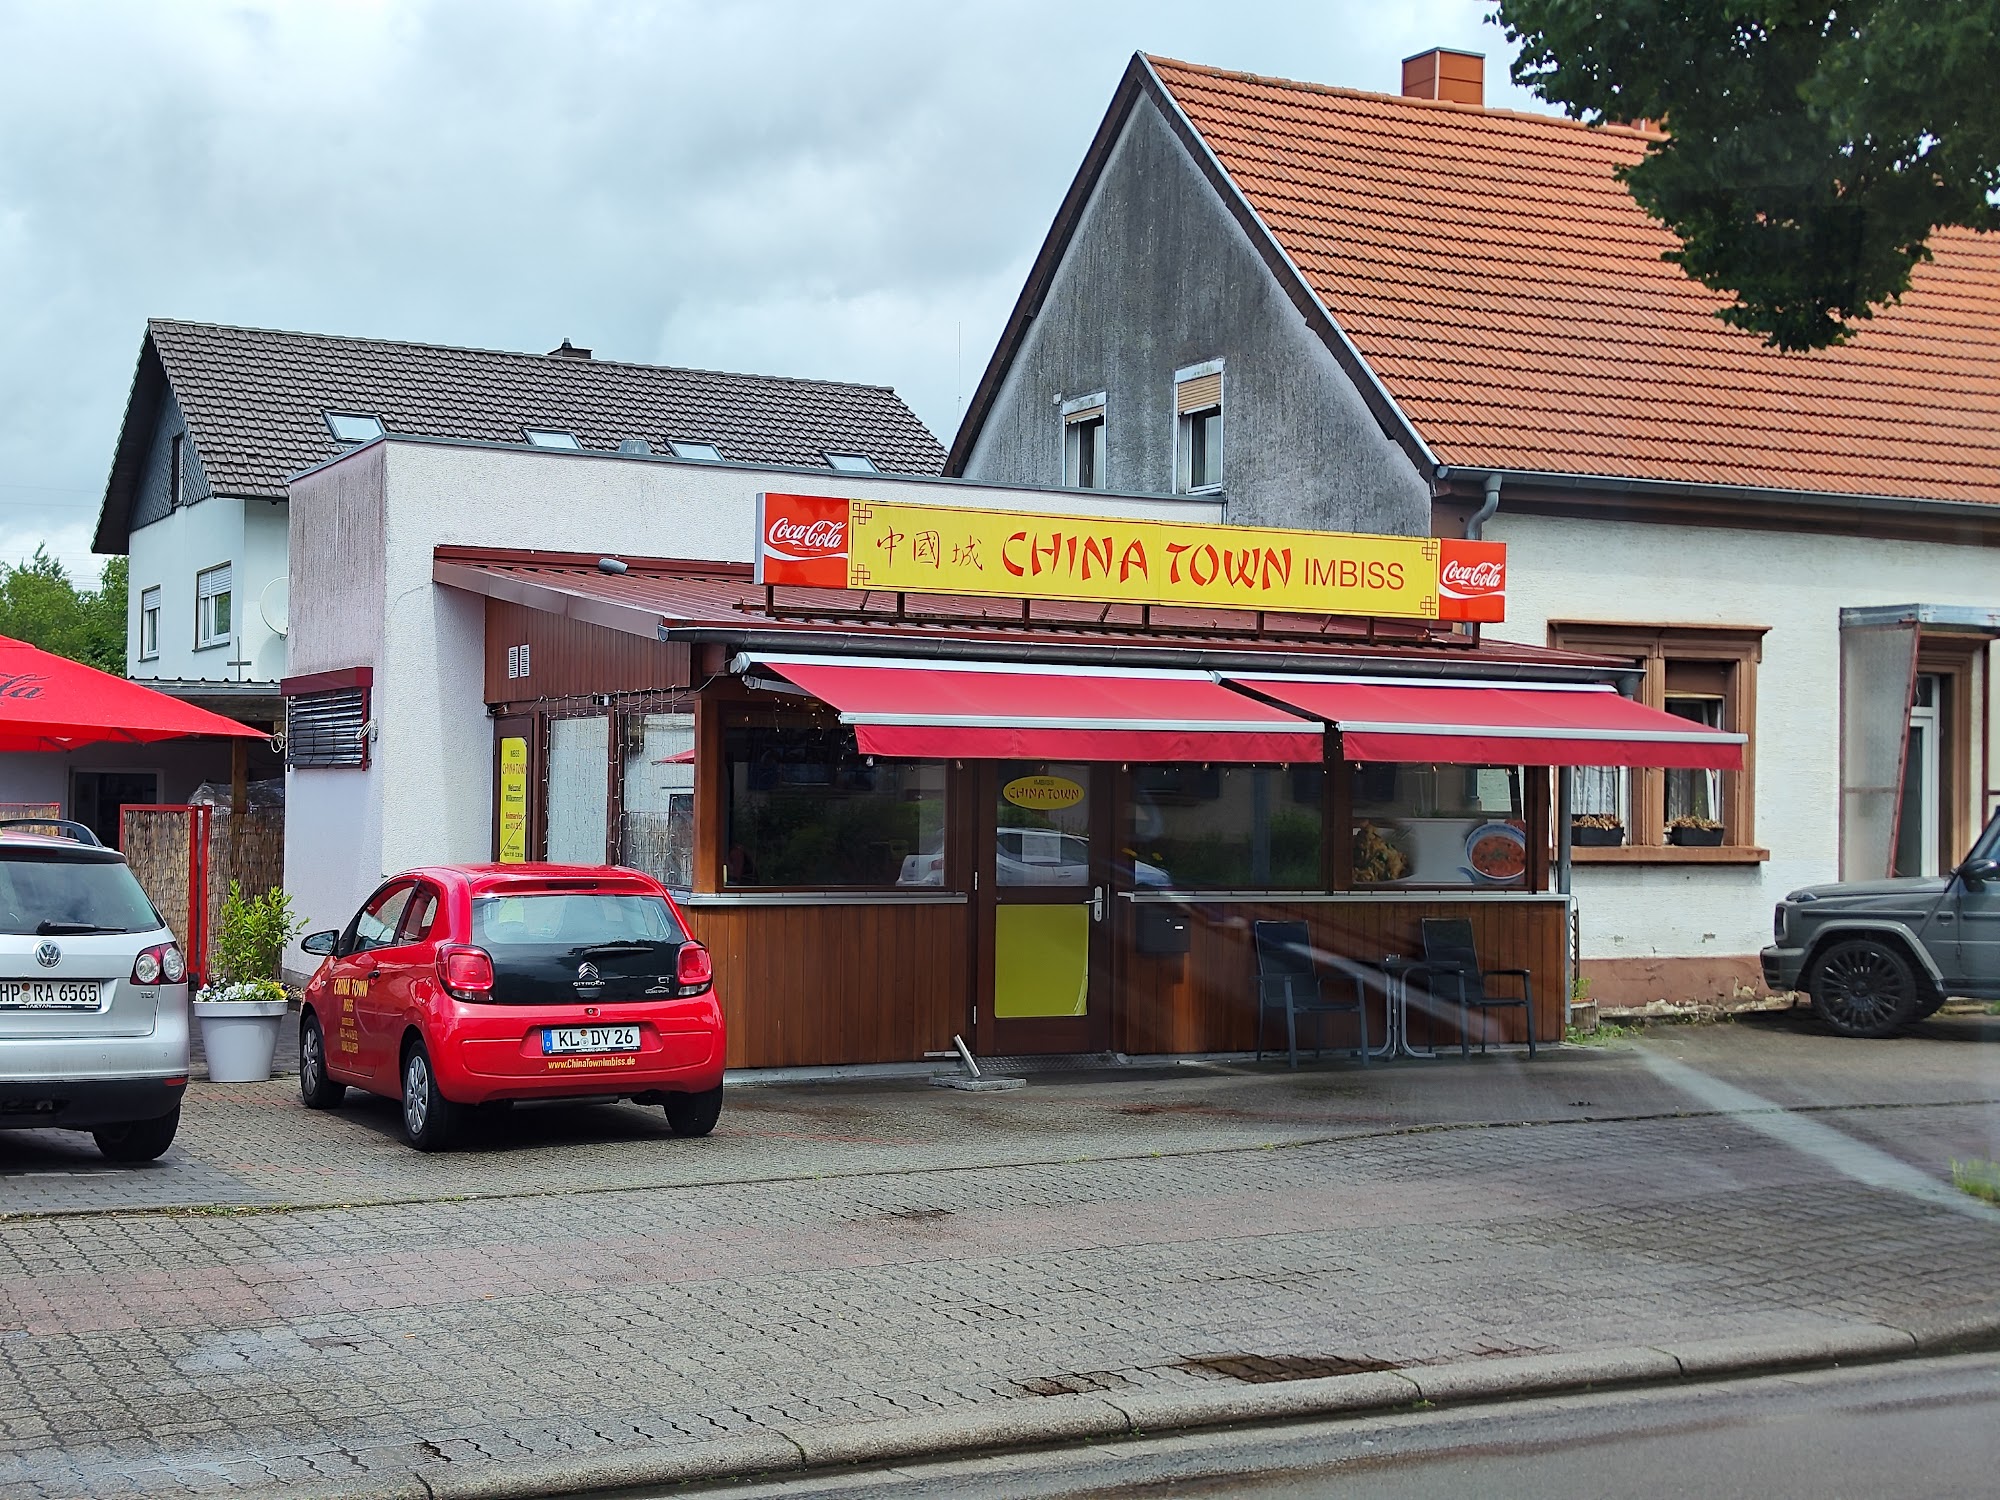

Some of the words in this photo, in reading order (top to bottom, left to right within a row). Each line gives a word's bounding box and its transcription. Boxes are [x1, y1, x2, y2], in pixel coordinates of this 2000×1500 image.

[768, 517, 847, 548] Coca-Cola
[876, 525, 983, 571] 中國城
[1002, 531, 1148, 584] CHINA
[1166, 541, 1292, 590] TOWN
[1304, 557, 1405, 590] IMBISS
[1442, 560, 1505, 587] Coca-Cola
[0, 983, 20, 1001] HP
[34, 983, 54, 1001] RA
[59, 984, 97, 1001] 6565
[558, 1031, 579, 1047] KL
[591, 1030, 611, 1045] DY
[614, 1029, 633, 1044] 26
[548, 1057, 636, 1069] www.ChinaTownImbiss.de
